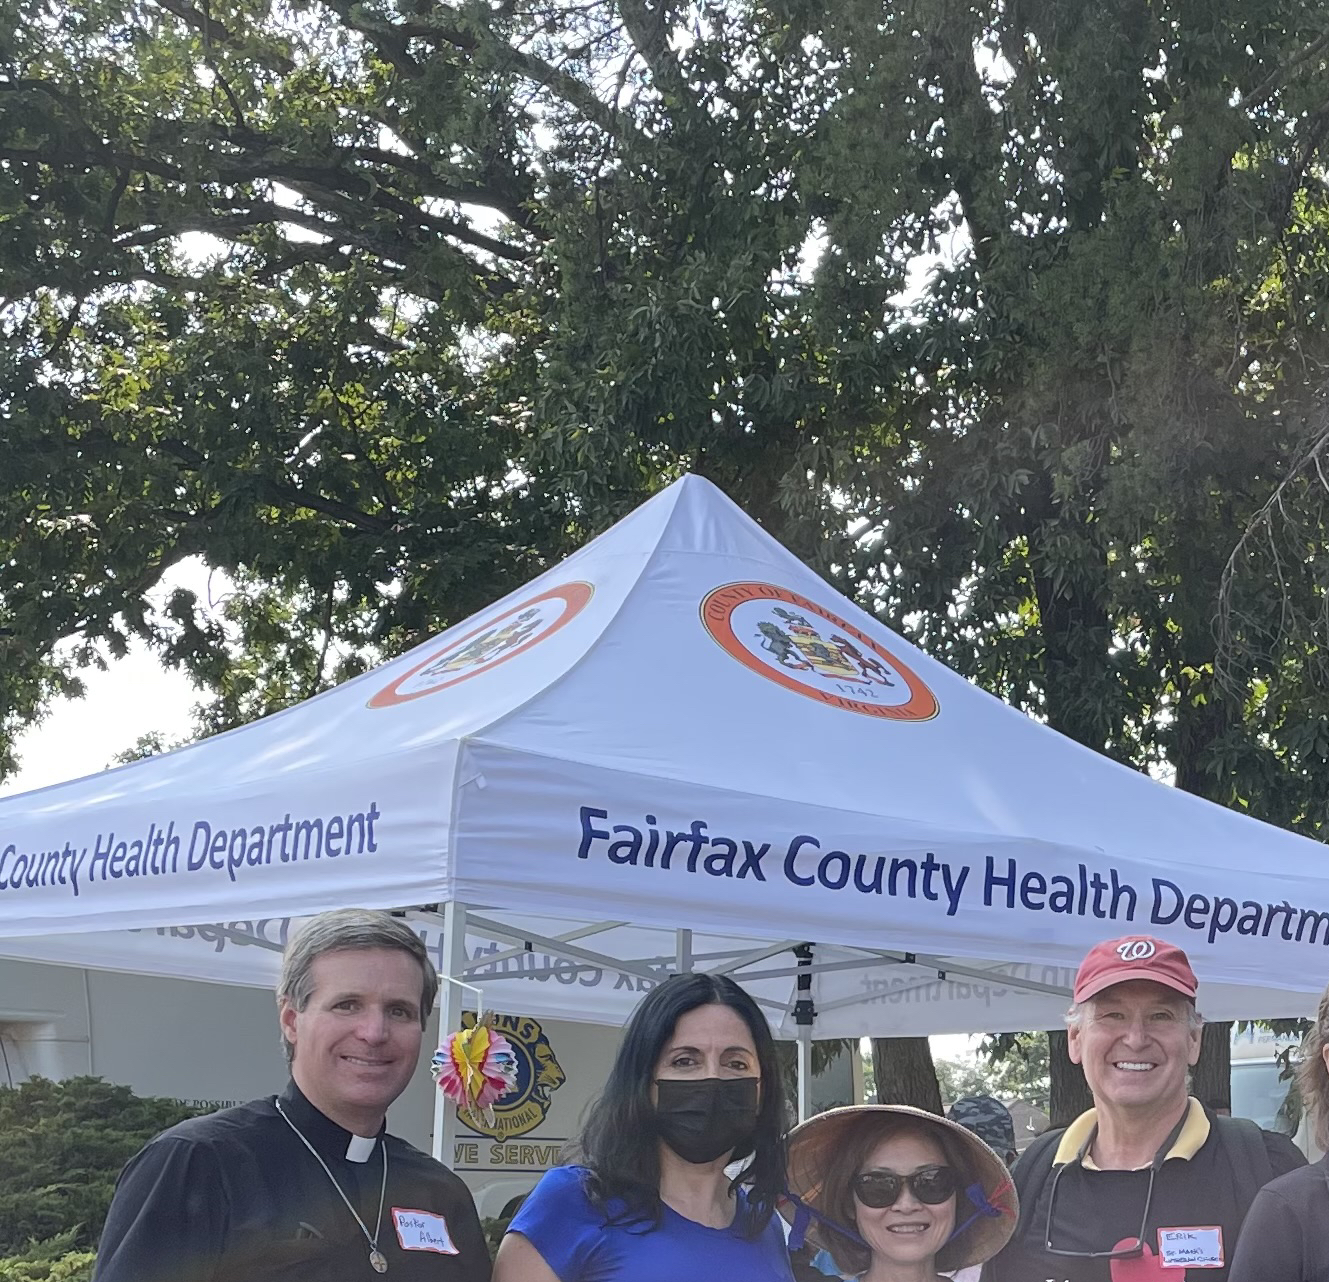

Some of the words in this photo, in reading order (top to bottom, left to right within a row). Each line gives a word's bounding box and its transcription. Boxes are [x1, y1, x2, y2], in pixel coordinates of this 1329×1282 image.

[835, 683, 879, 699] 1742
[0, 841, 87, 897] County
[89, 820, 181, 883] Health
[187, 801, 381, 882] Department
[577, 806, 772, 882] Fairfax
[783, 835, 971, 917] County
[983, 855, 1138, 921] Health
[1116, 940, 1156, 962] W
[1166, 1232, 1198, 1241] ERIK
